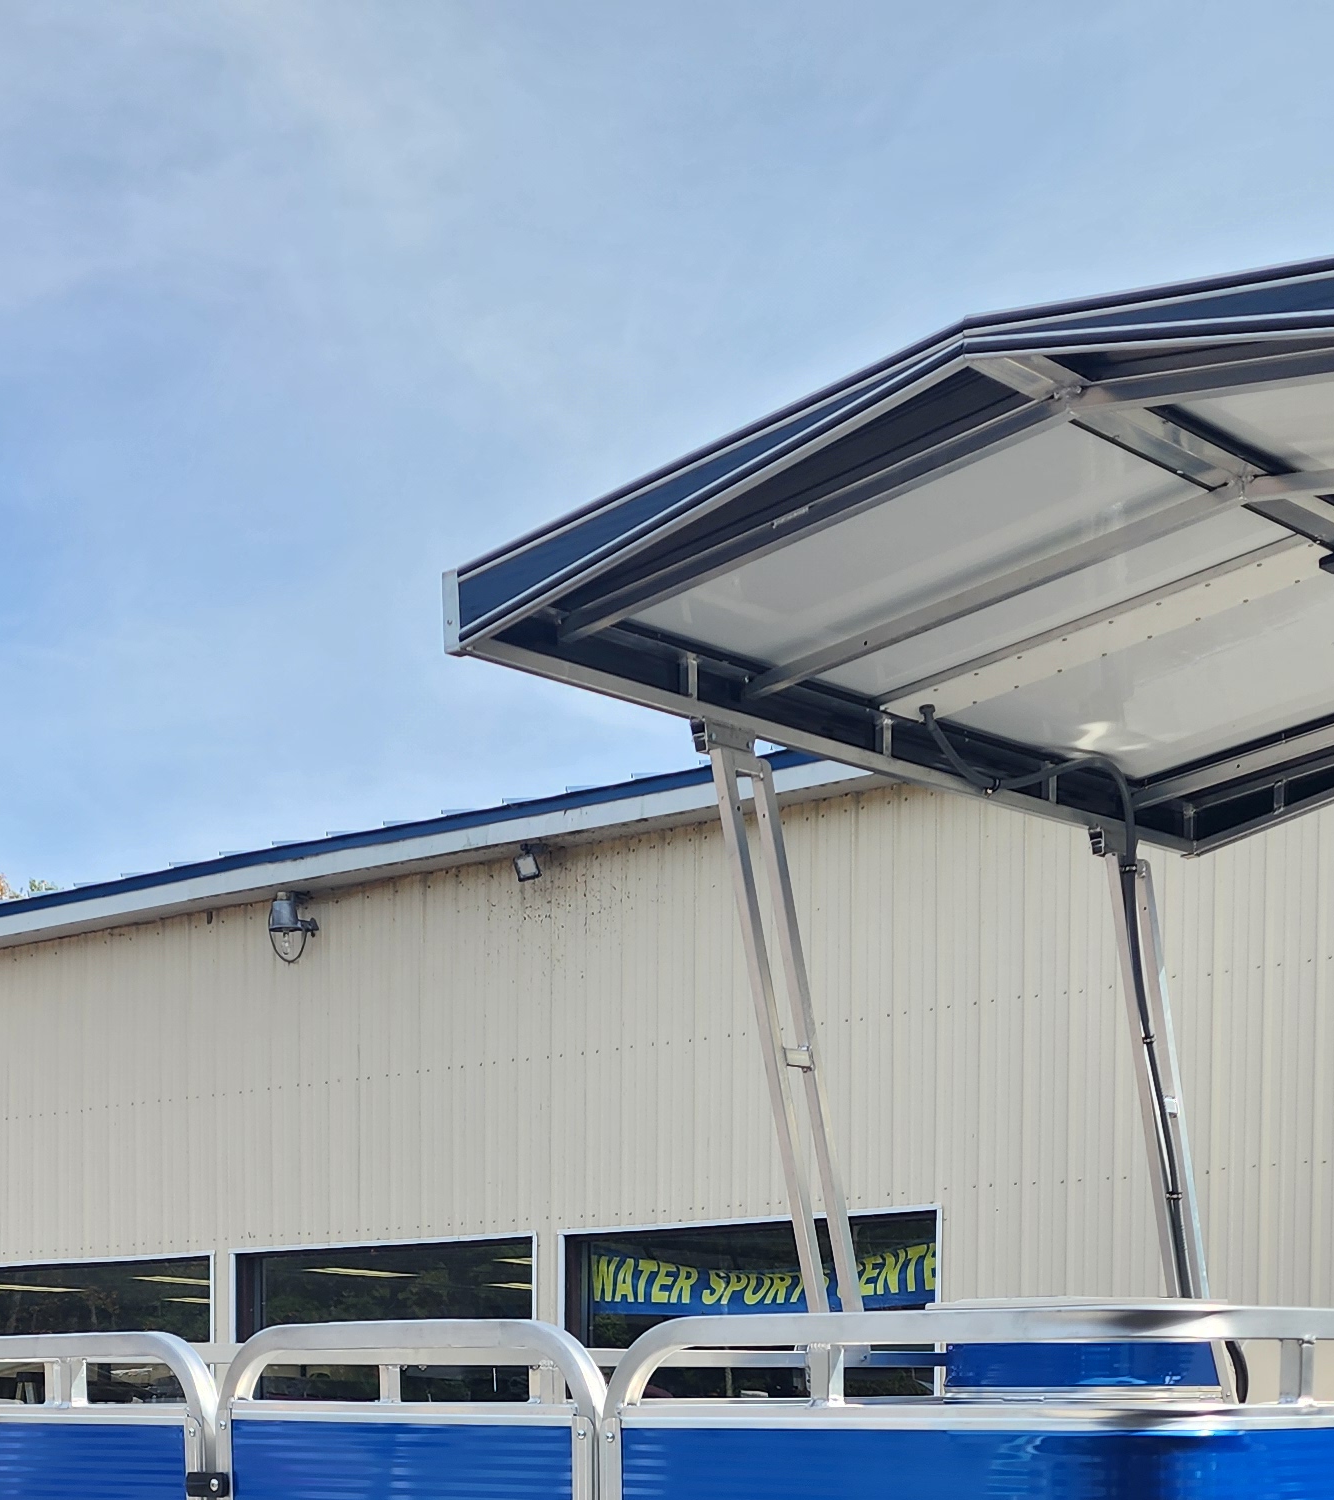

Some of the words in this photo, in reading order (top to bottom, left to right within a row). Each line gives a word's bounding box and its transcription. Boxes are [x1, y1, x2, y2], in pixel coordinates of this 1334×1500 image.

[591, 1254, 698, 1304] WATER
[702, 1268, 830, 1306] SPORT
[837, 1243, 936, 1299] ENTE
